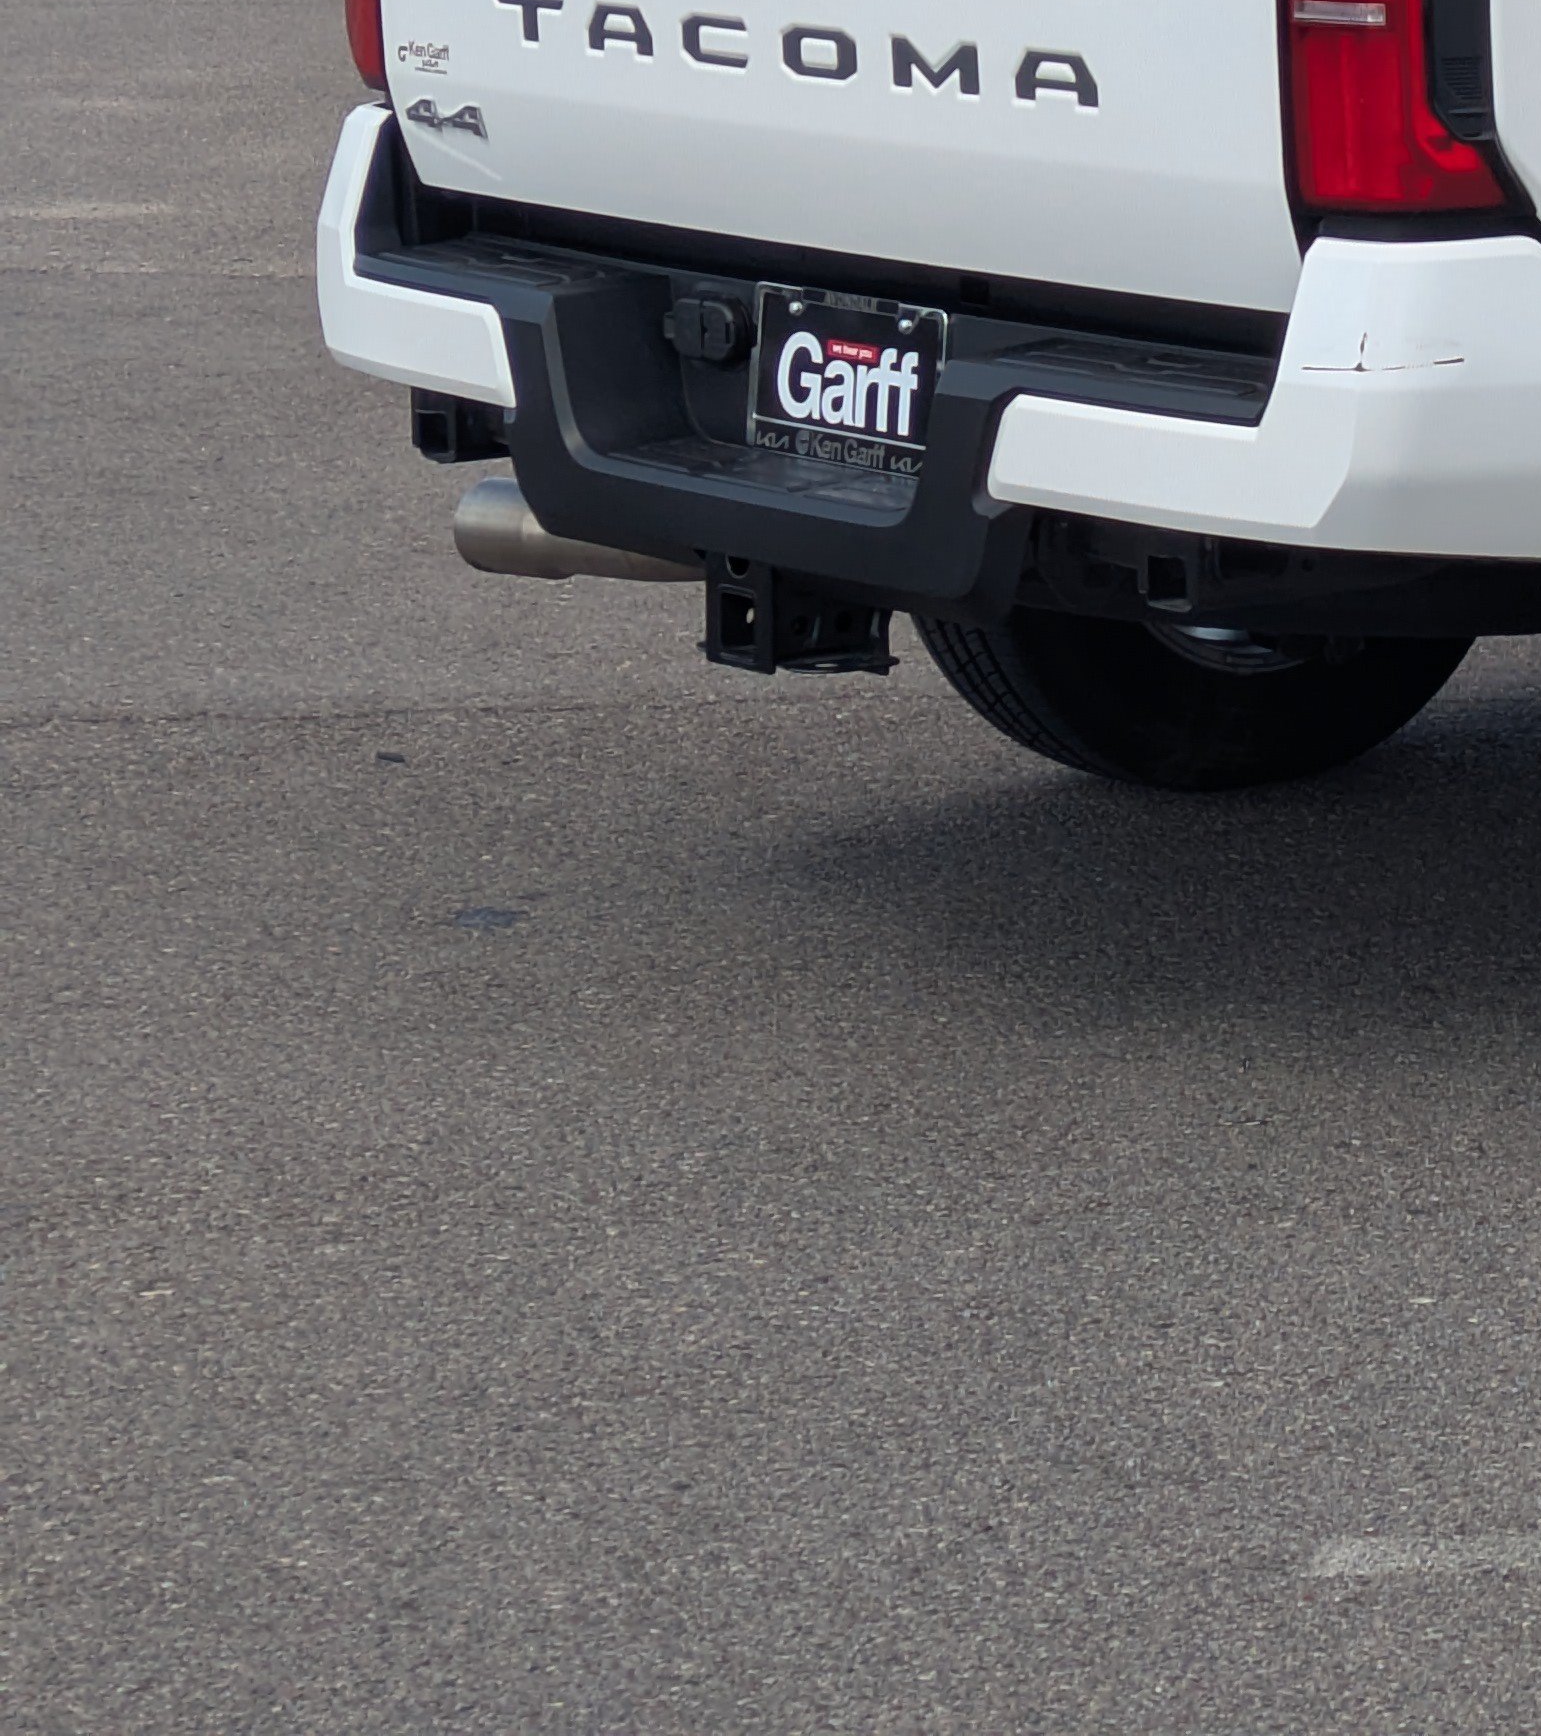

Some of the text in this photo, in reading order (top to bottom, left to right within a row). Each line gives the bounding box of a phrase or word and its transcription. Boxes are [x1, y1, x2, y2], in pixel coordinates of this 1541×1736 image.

[777, 331, 920, 437] Garff
[809, 431, 842, 461] Ken
[843, 438, 886, 470] Garff
